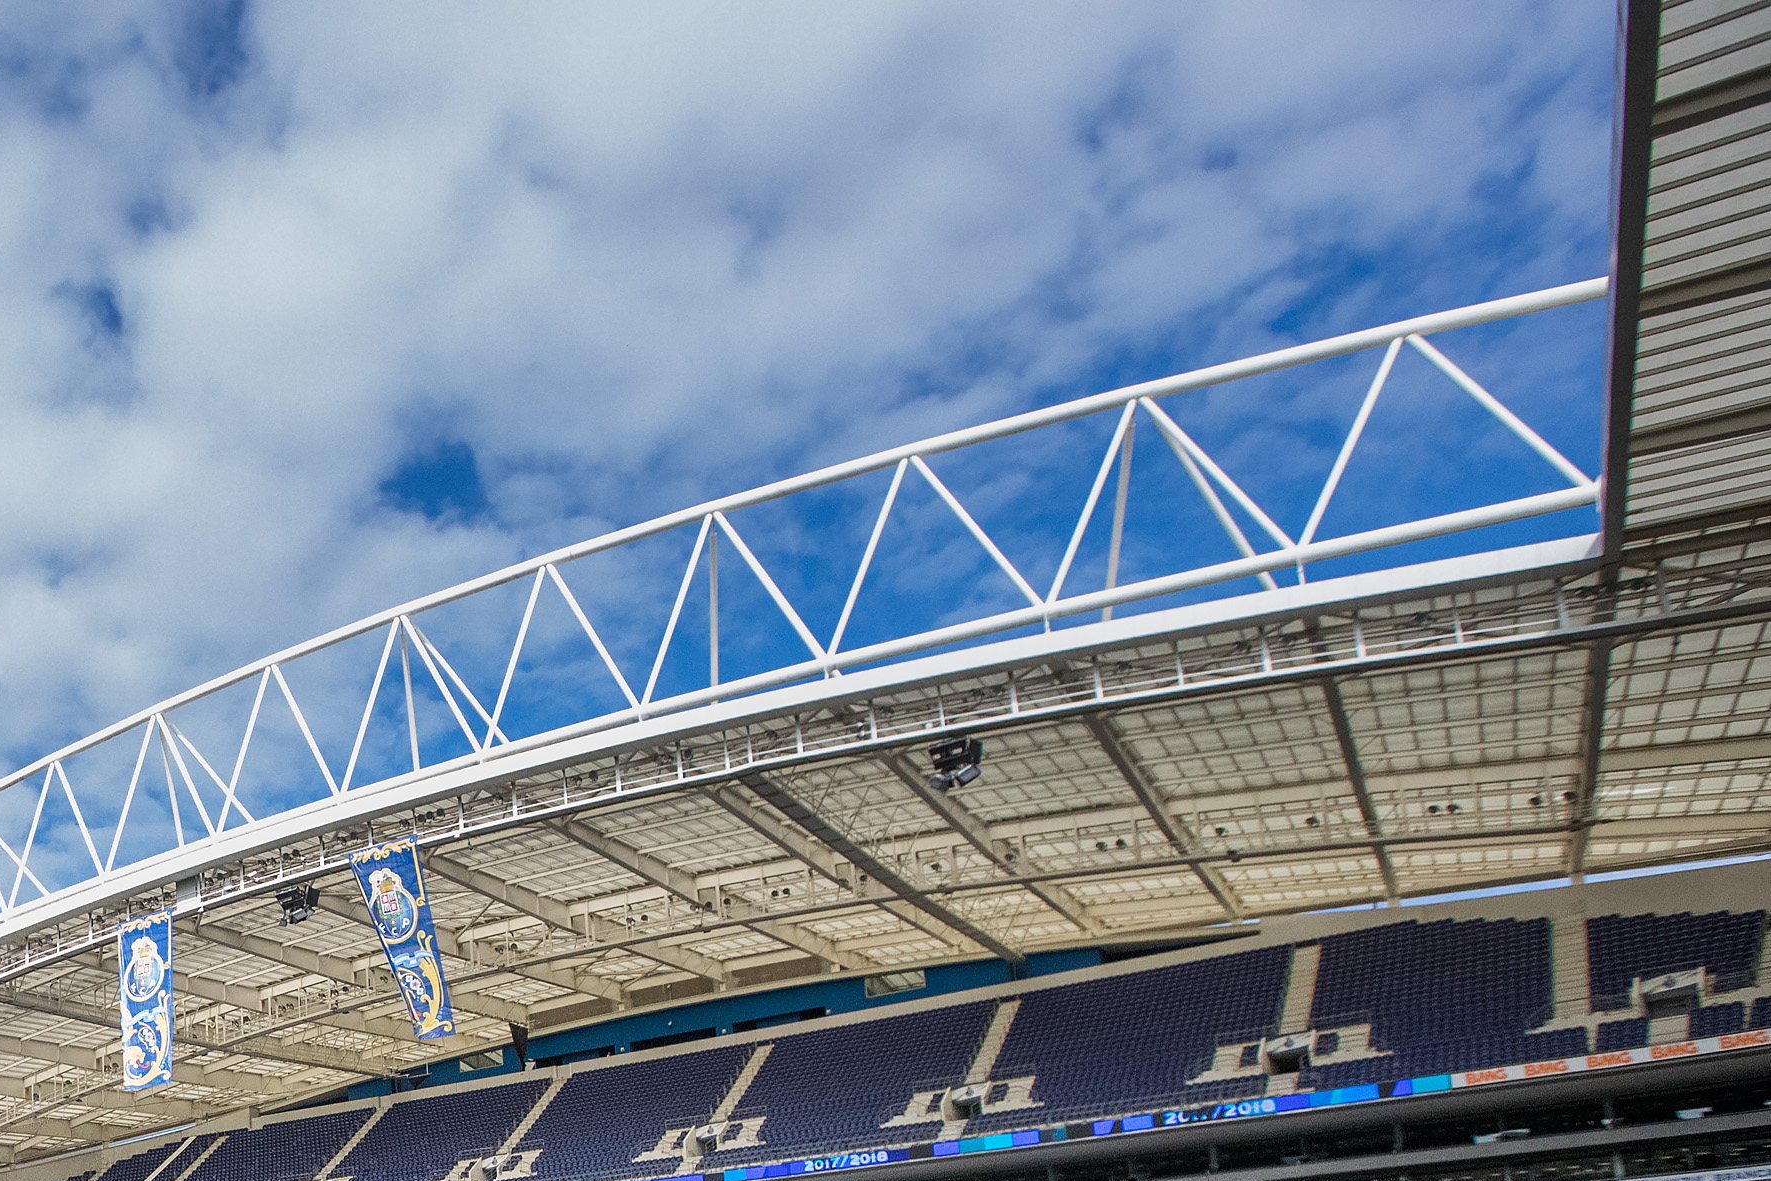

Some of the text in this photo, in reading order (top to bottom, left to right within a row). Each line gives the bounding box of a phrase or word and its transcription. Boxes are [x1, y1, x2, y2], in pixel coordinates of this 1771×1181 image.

[1465, 1030, 1769, 1085] BMG BMG BMG BMG BMG
[804, 1150, 888, 1172] 2017/2018
